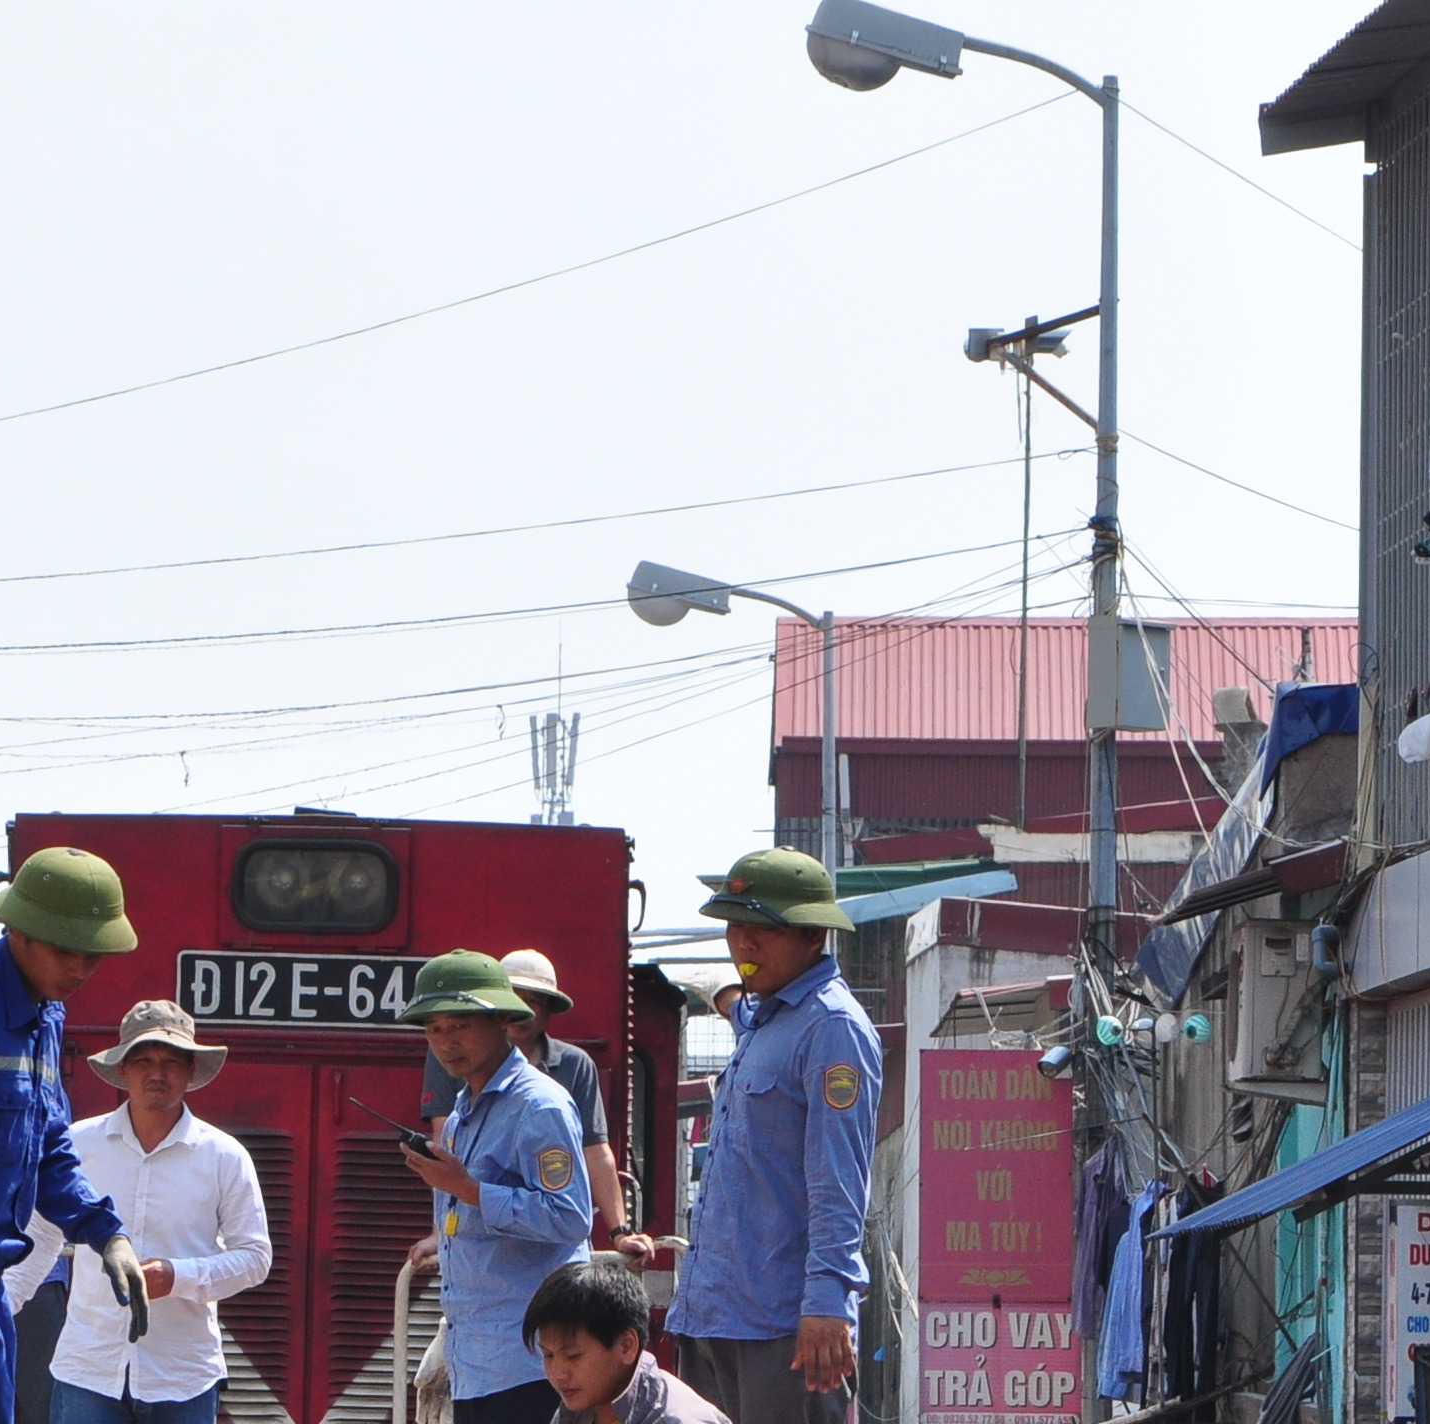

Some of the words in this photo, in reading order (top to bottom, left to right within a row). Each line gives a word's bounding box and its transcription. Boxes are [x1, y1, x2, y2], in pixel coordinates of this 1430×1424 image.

[190, 959, 422, 1020] Đ12E-64
[938, 1062, 997, 1100] TOÀN
[1005, 1064, 1052, 1100] DÂN
[933, 1113, 971, 1150] NÓI
[980, 1115, 1059, 1150] KHÔNG
[977, 1163, 1012, 1200] VỚI
[946, 1221, 982, 1251] MA
[990, 1214, 1031, 1251] TÚY
[925, 1311, 996, 1350] CHO
[1009, 1312, 1073, 1349] VAY
[1407, 1316, 1430, 1333] CHO
[925, 1354, 992, 1406] TRẢ
[1004, 1362, 1076, 1408] GÓP
